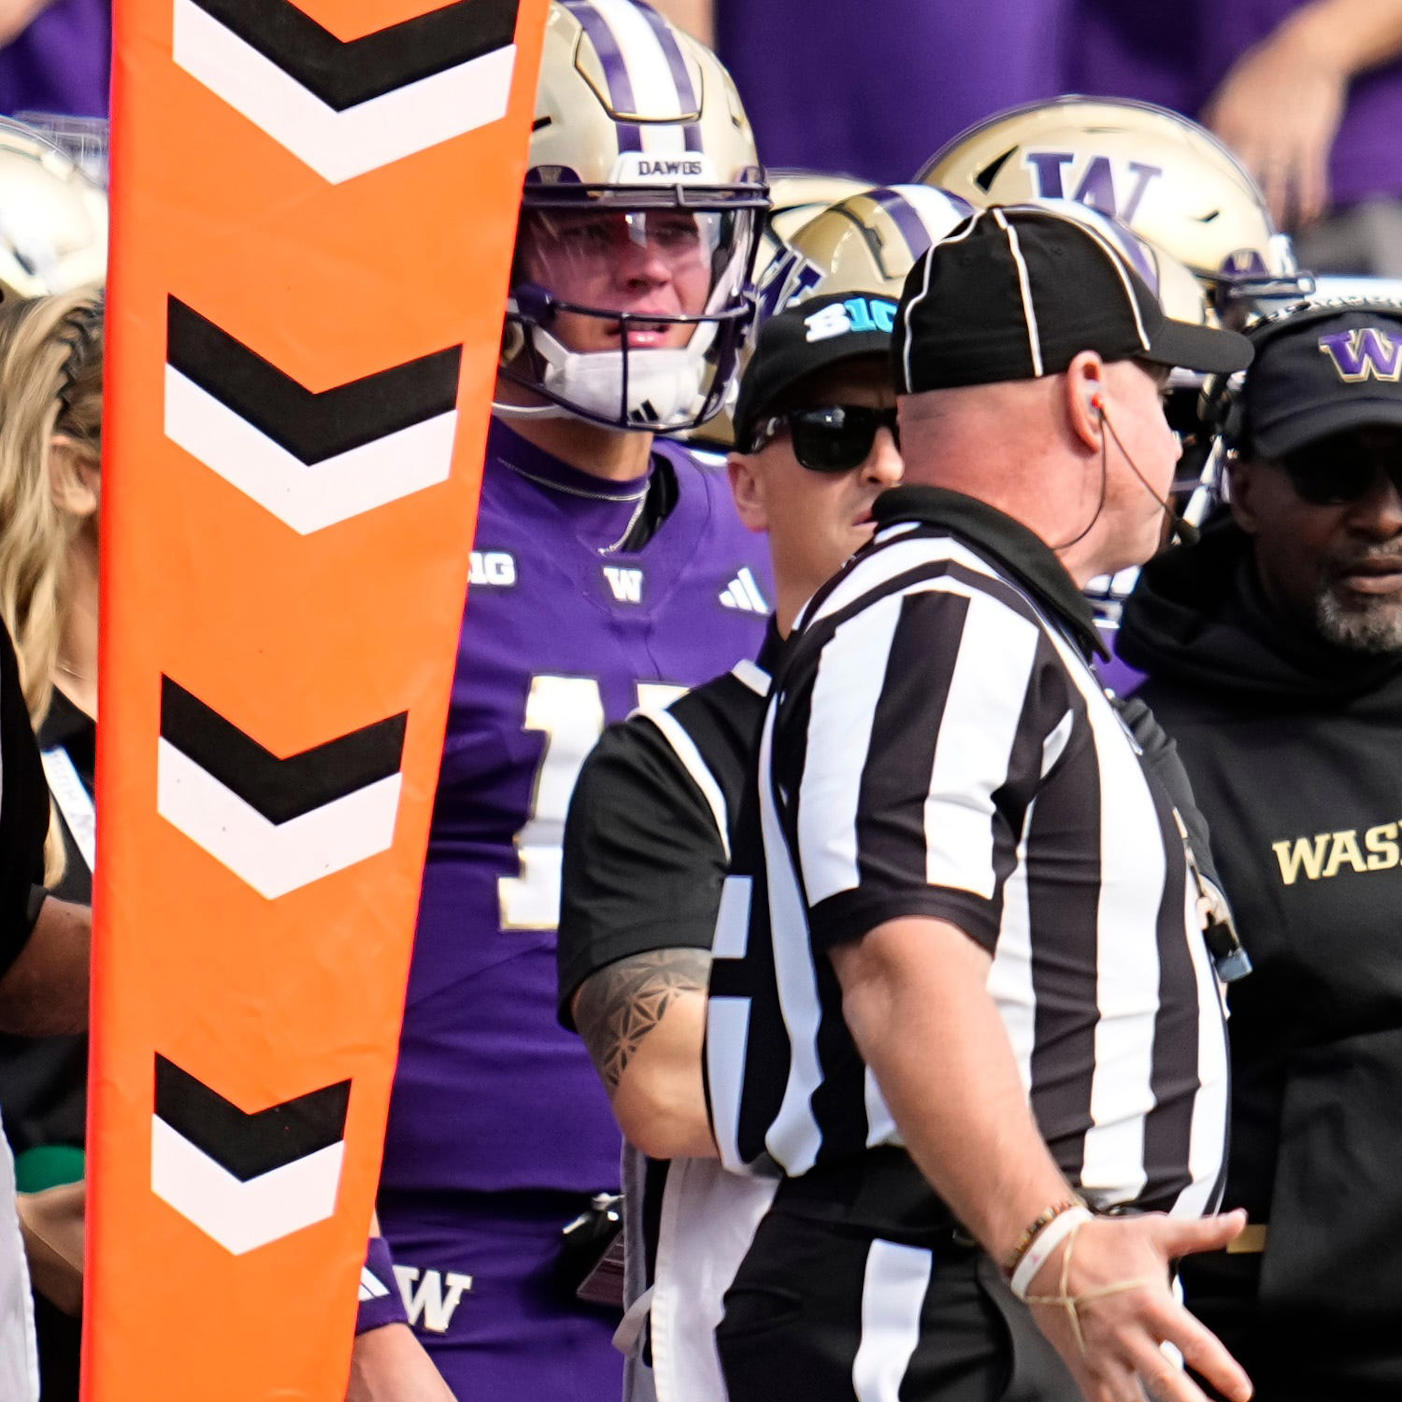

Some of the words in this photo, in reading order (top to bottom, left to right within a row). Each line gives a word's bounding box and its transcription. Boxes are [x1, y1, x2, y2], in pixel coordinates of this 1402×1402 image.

[1023, 151, 1164, 227] W
[604, 567, 643, 603] W
[392, 1264, 473, 1333] W
